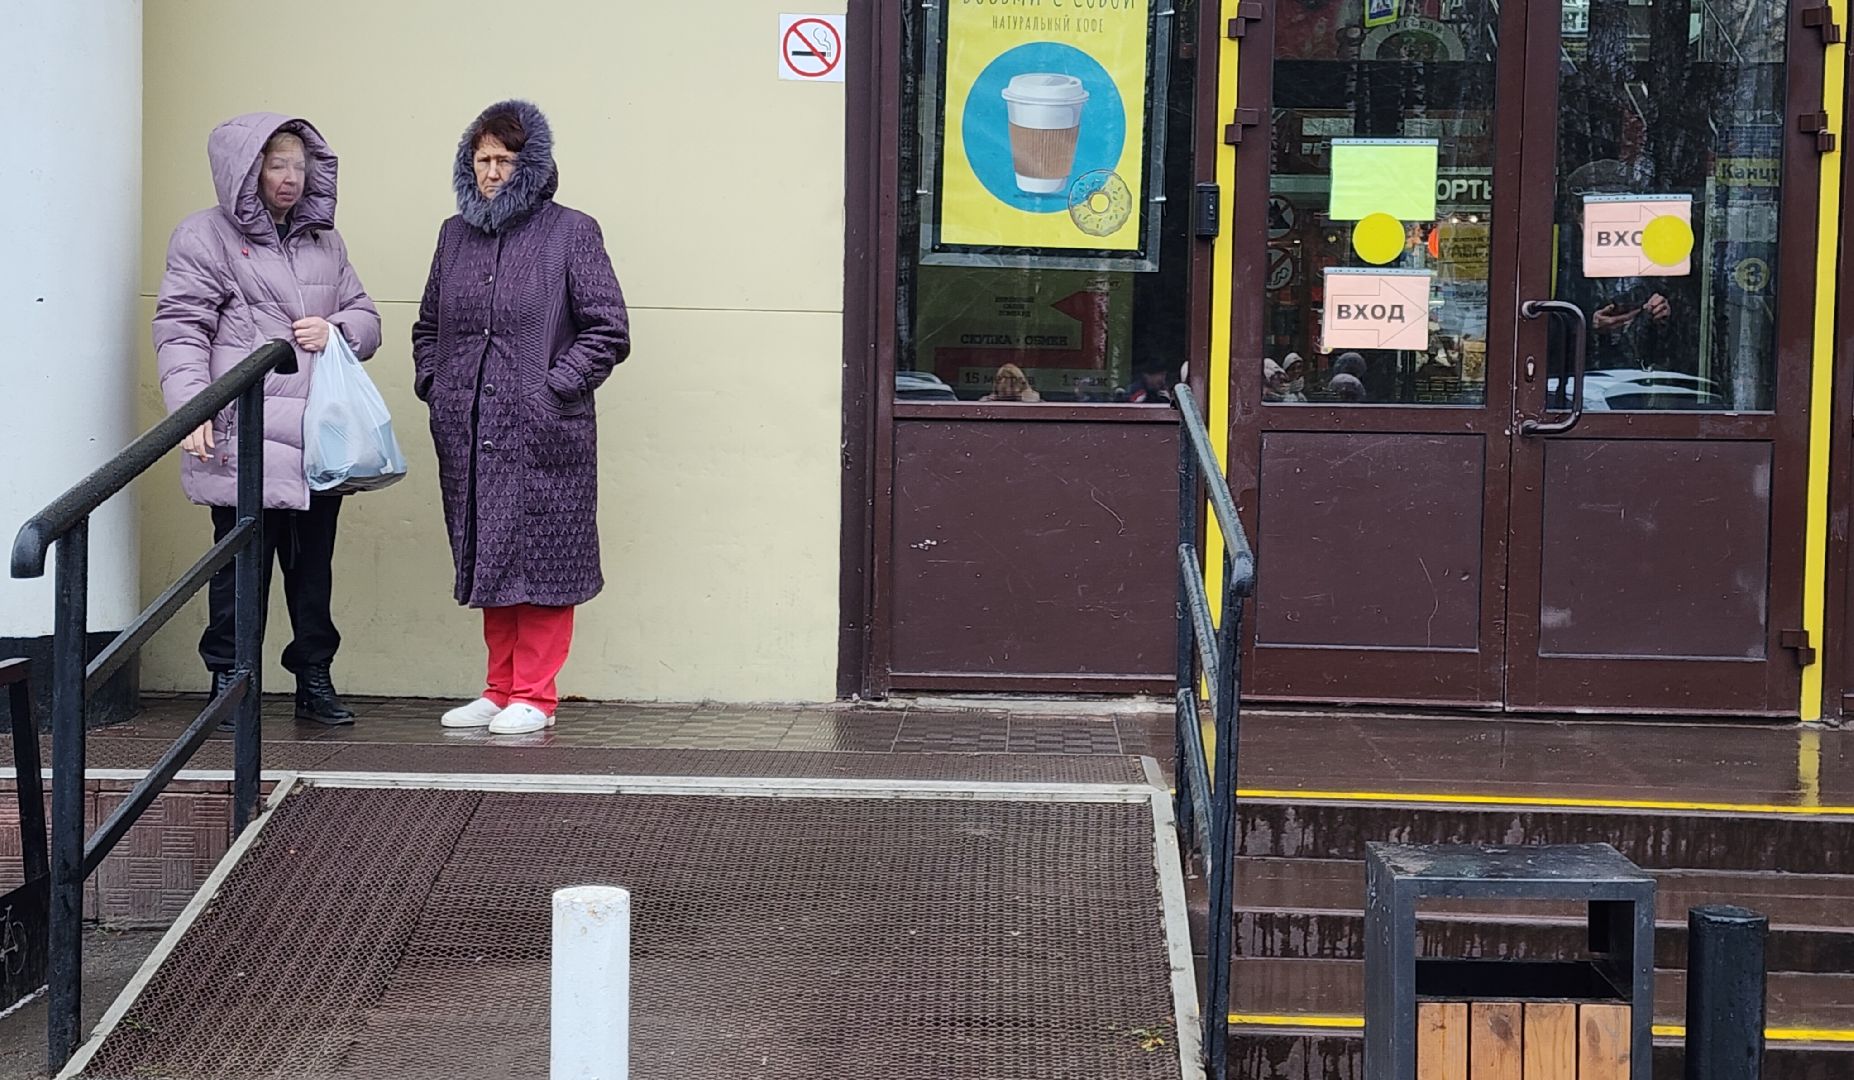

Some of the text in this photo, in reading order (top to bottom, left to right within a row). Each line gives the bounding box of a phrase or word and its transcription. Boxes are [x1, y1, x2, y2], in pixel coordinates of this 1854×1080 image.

[992, 15, 1104, 33] НАТУРАЛЬНЫЙ КОФЕ
[1597, 231, 1644, 247] ВХО
[1337, 304, 1405, 323] ВХОД
